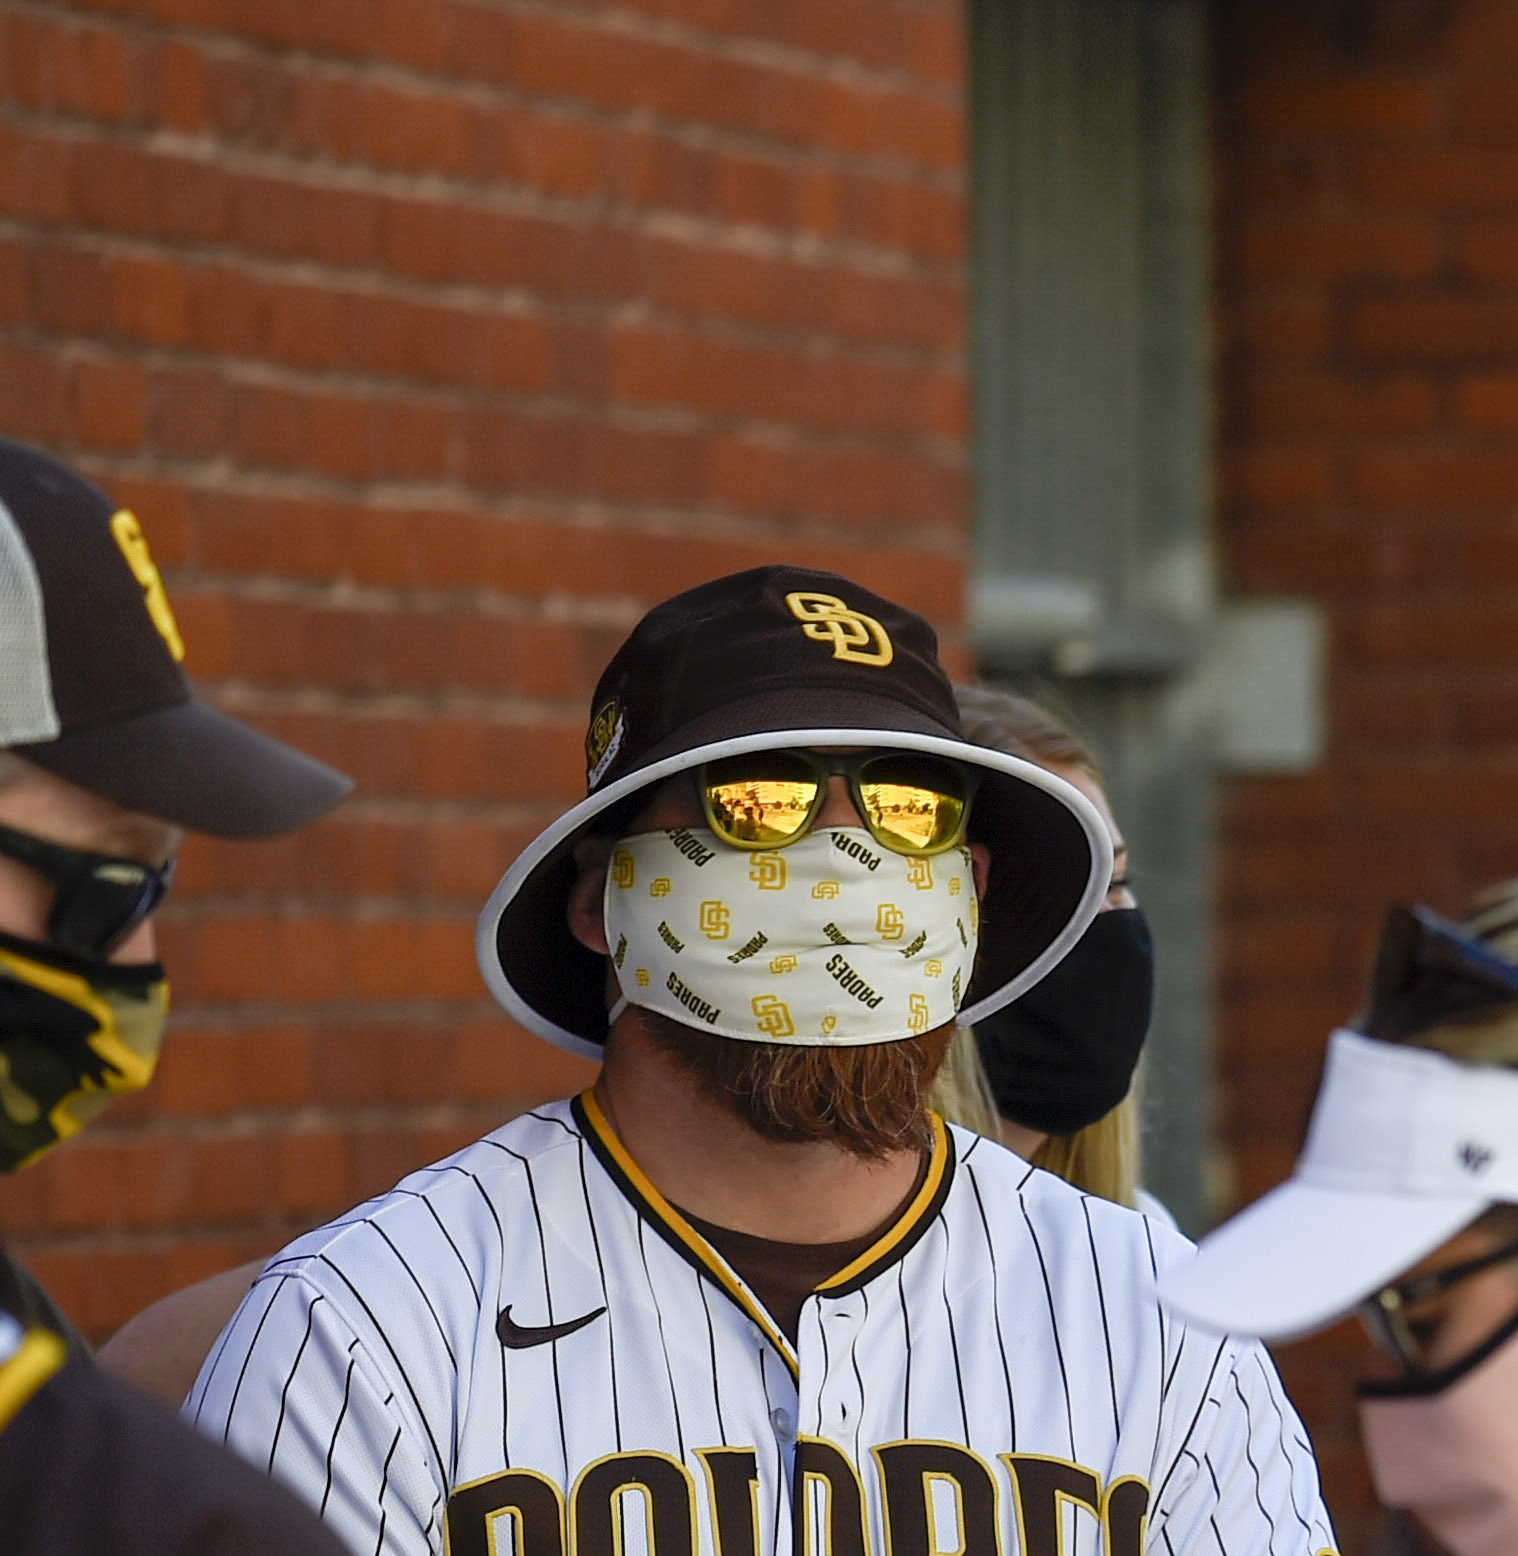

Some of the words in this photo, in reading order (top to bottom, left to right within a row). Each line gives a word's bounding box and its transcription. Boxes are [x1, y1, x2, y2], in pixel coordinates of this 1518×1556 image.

[785, 592, 894, 667] SD
[831, 832, 881, 871] PADR
[657, 921, 685, 954] PADRES
[728, 931, 769, 964] PADRES
[666, 972, 721, 1025] PADRES
[826, 954, 884, 1009] PADRES
